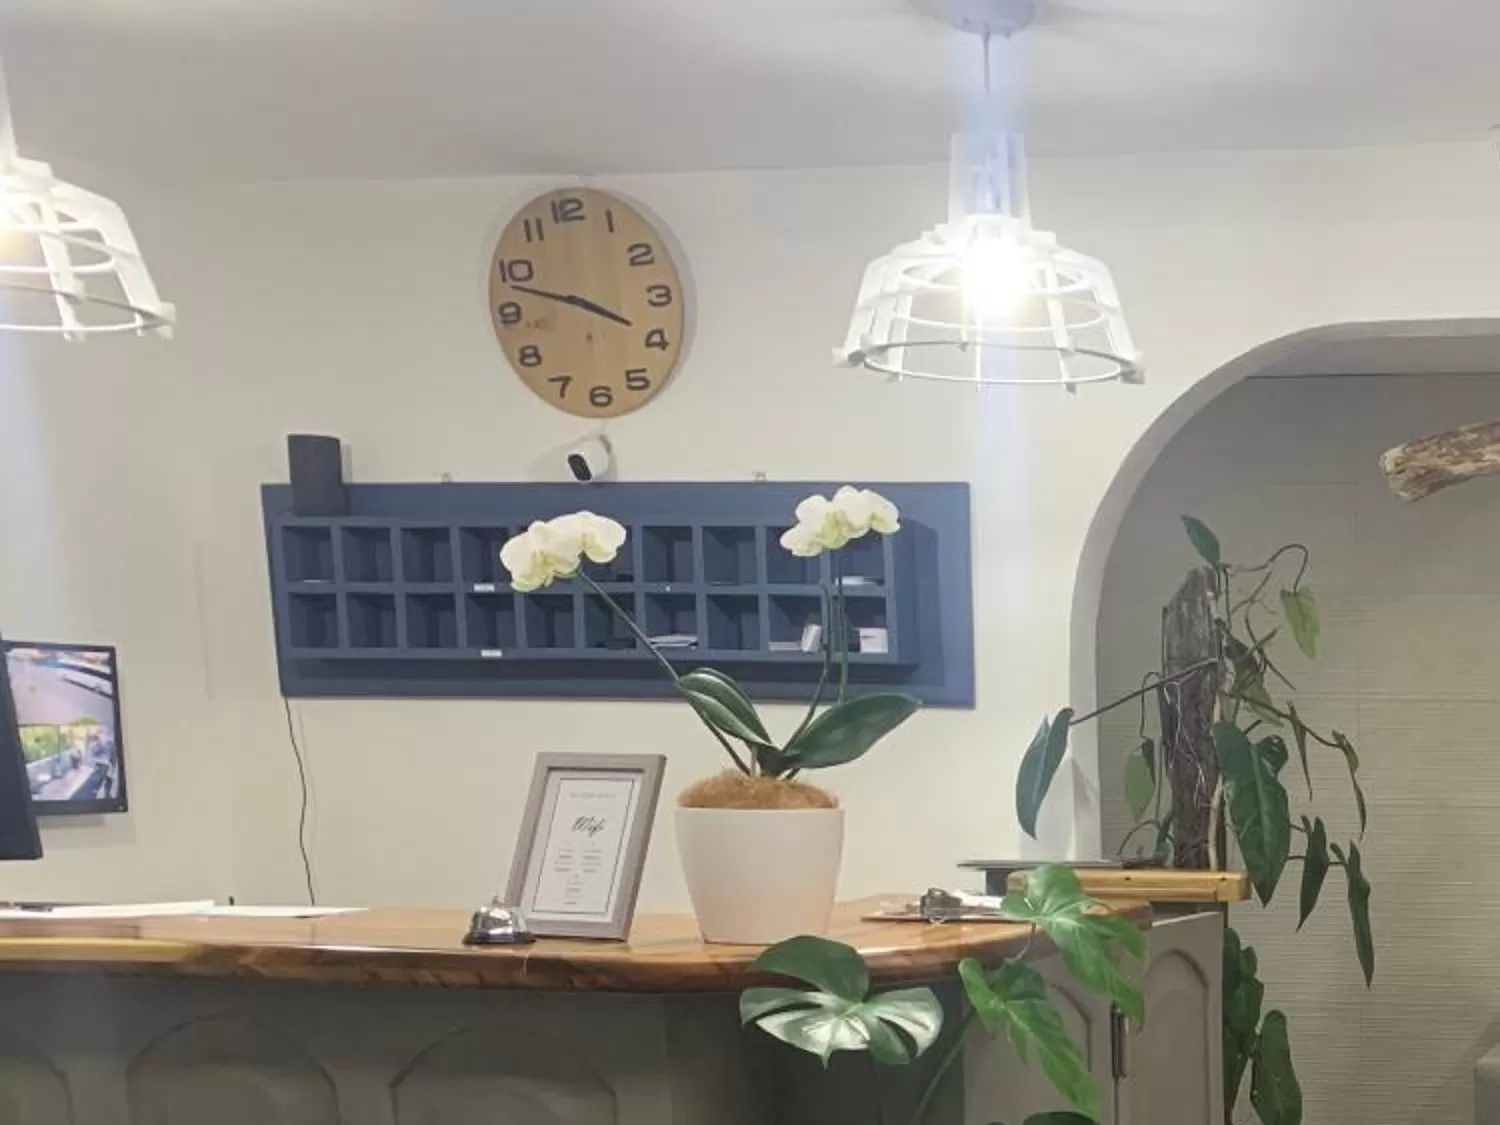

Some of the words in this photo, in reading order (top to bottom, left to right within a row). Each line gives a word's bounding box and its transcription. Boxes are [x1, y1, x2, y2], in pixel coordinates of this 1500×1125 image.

[551, 198, 586, 224] 12
[606, 210, 614, 233] 1
[524, 218, 544, 242] 11
[627, 243, 655, 267] 2
[499, 259, 534, 283] 10
[646, 284, 673, 307] 3
[498, 302, 522, 325] 9
[645, 328, 669, 351] 4
[519, 345, 542, 367] 8
[547, 376, 574, 399] 7
[625, 368, 650, 391] 5
[589, 386, 613, 407] 6
